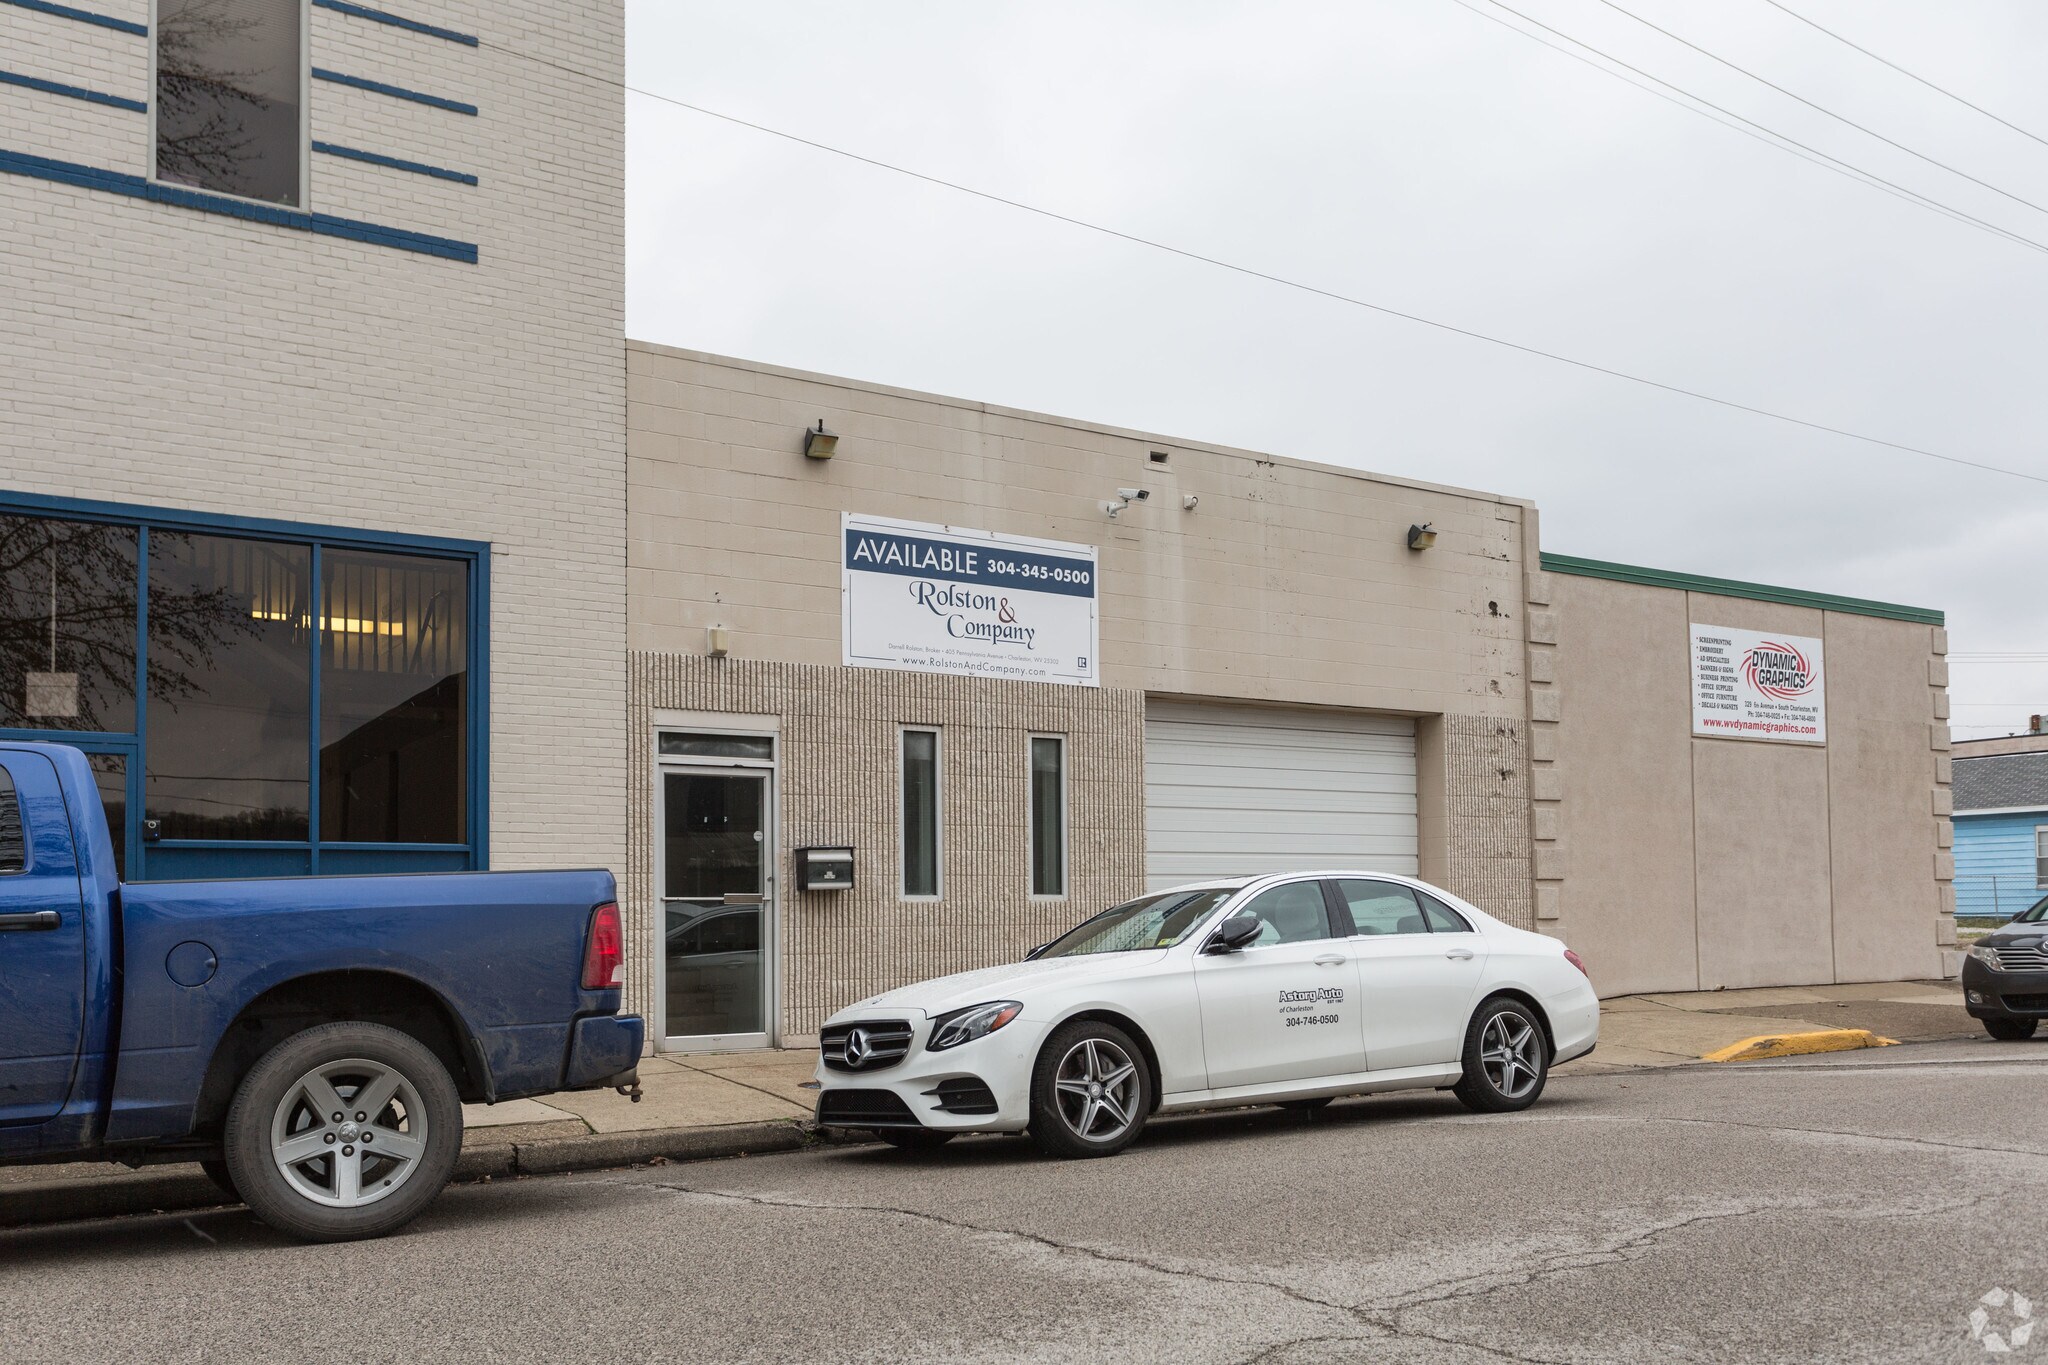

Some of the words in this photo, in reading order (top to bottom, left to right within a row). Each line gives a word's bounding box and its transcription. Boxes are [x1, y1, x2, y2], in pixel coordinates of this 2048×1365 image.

[853, 538, 977, 575] AVAILABLE
[987, 559, 1090, 585] 304-345-0500
[909, 580, 996, 616] Rolston
[998, 597, 1018, 623] &
[947, 614, 1035, 650] Company
[1699, 636, 1732, 646] SCREENPRINTING
[888, 643, 905, 651] Darrell
[956, 649, 986, 659] Pennsylvania
[987, 652, 1004, 660] Avenue
[1699, 646, 1723, 654] EMBROIDERY
[902, 657, 1046, 676] www.RolstonAndCompany.com
[1706, 656, 1730, 664] SPECIALTIES
[1752, 650, 1797, 671] DYNAMIC
[1758, 669, 1806, 689] GRAPHICS
[1778, 703, 1789, 711] South
[1703, 719, 1816, 734] www.wvdynamicgraphics.com
[1279, 990, 1317, 1003] Astorg
[1317, 988, 1343, 1000] Auto
[1286, 1005, 1314, 1013] Charleston
[1285, 1014, 1339, 1027] 304-746-0500
